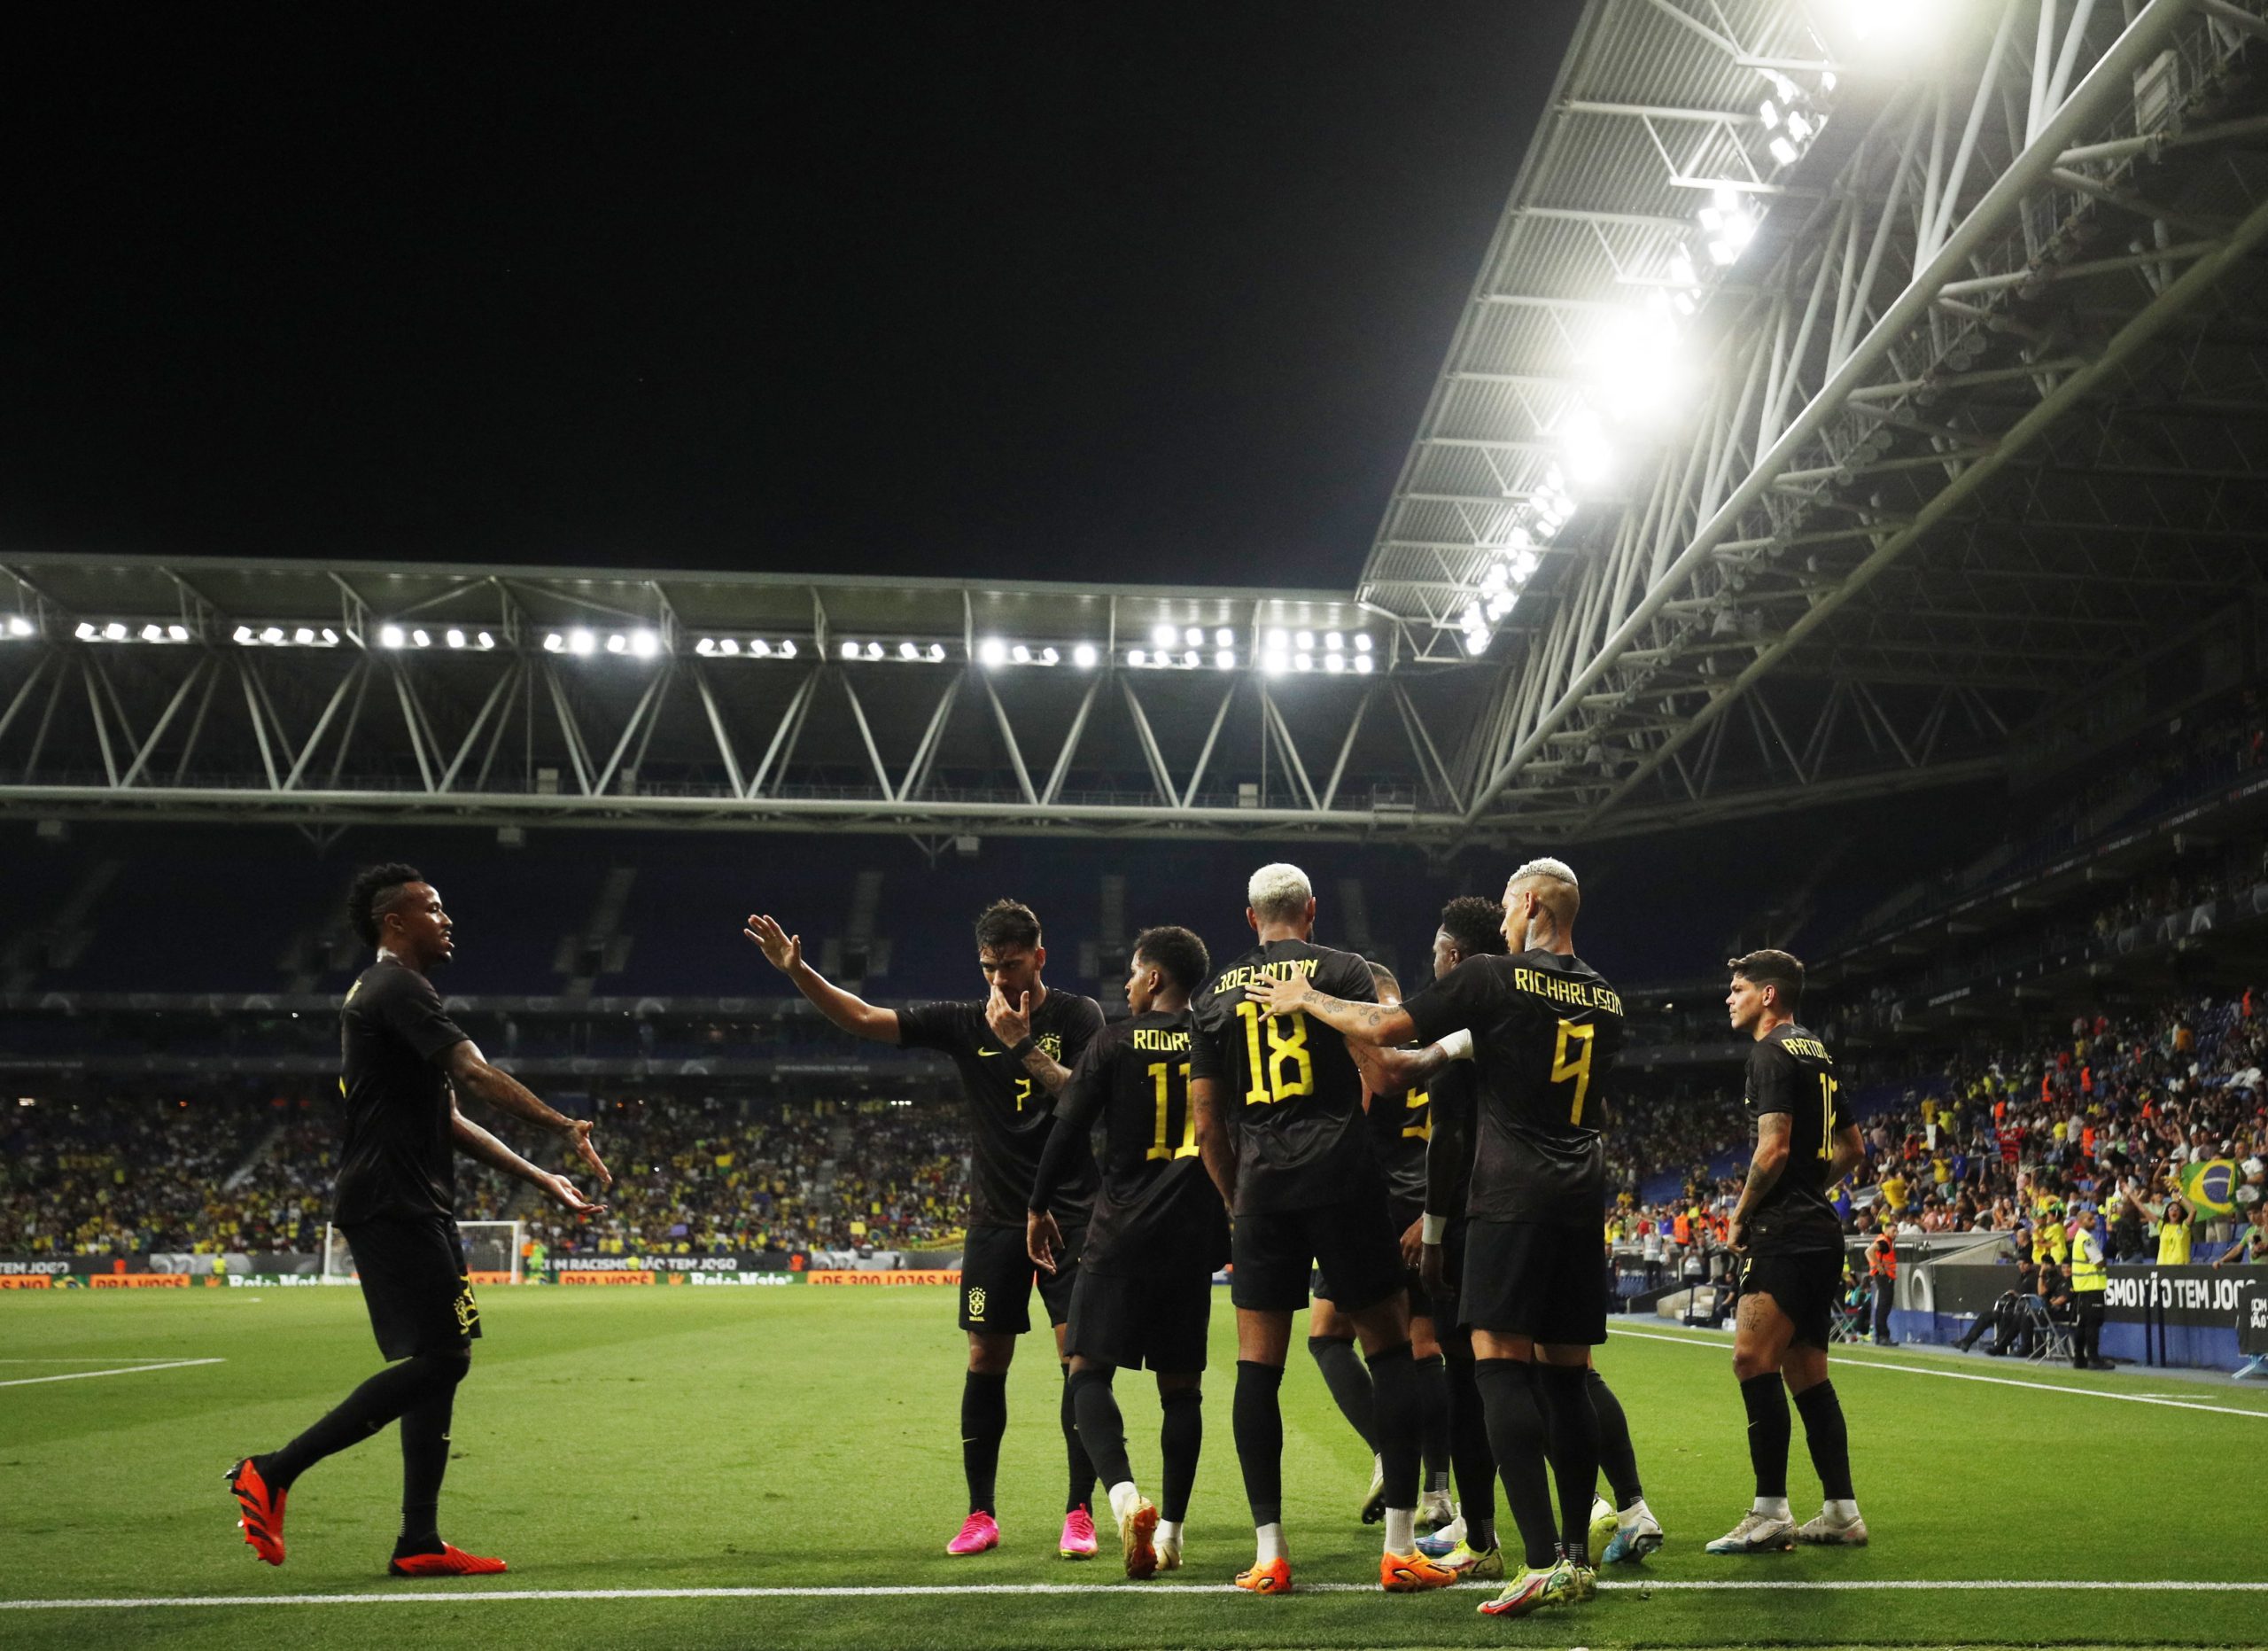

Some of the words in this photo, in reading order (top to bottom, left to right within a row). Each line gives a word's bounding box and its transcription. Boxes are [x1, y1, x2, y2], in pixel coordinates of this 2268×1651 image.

[1514, 968, 1623, 1016] RICHARLISON
[1236, 1001, 1314, 1106] 18
[1550, 1016, 1594, 1127] 9
[1015, 1079, 1031, 1111] 7
[1146, 1063, 1200, 1162] 11
[0, 1261, 26, 1274] EM
[667, 1258, 697, 1271] TEM
[699, 1258, 737, 1271] JOGO
[850, 1275, 881, 1285] 300
[2174, 1279, 2210, 1309] TEM
[2212, 1279, 2256, 1311] JOG
